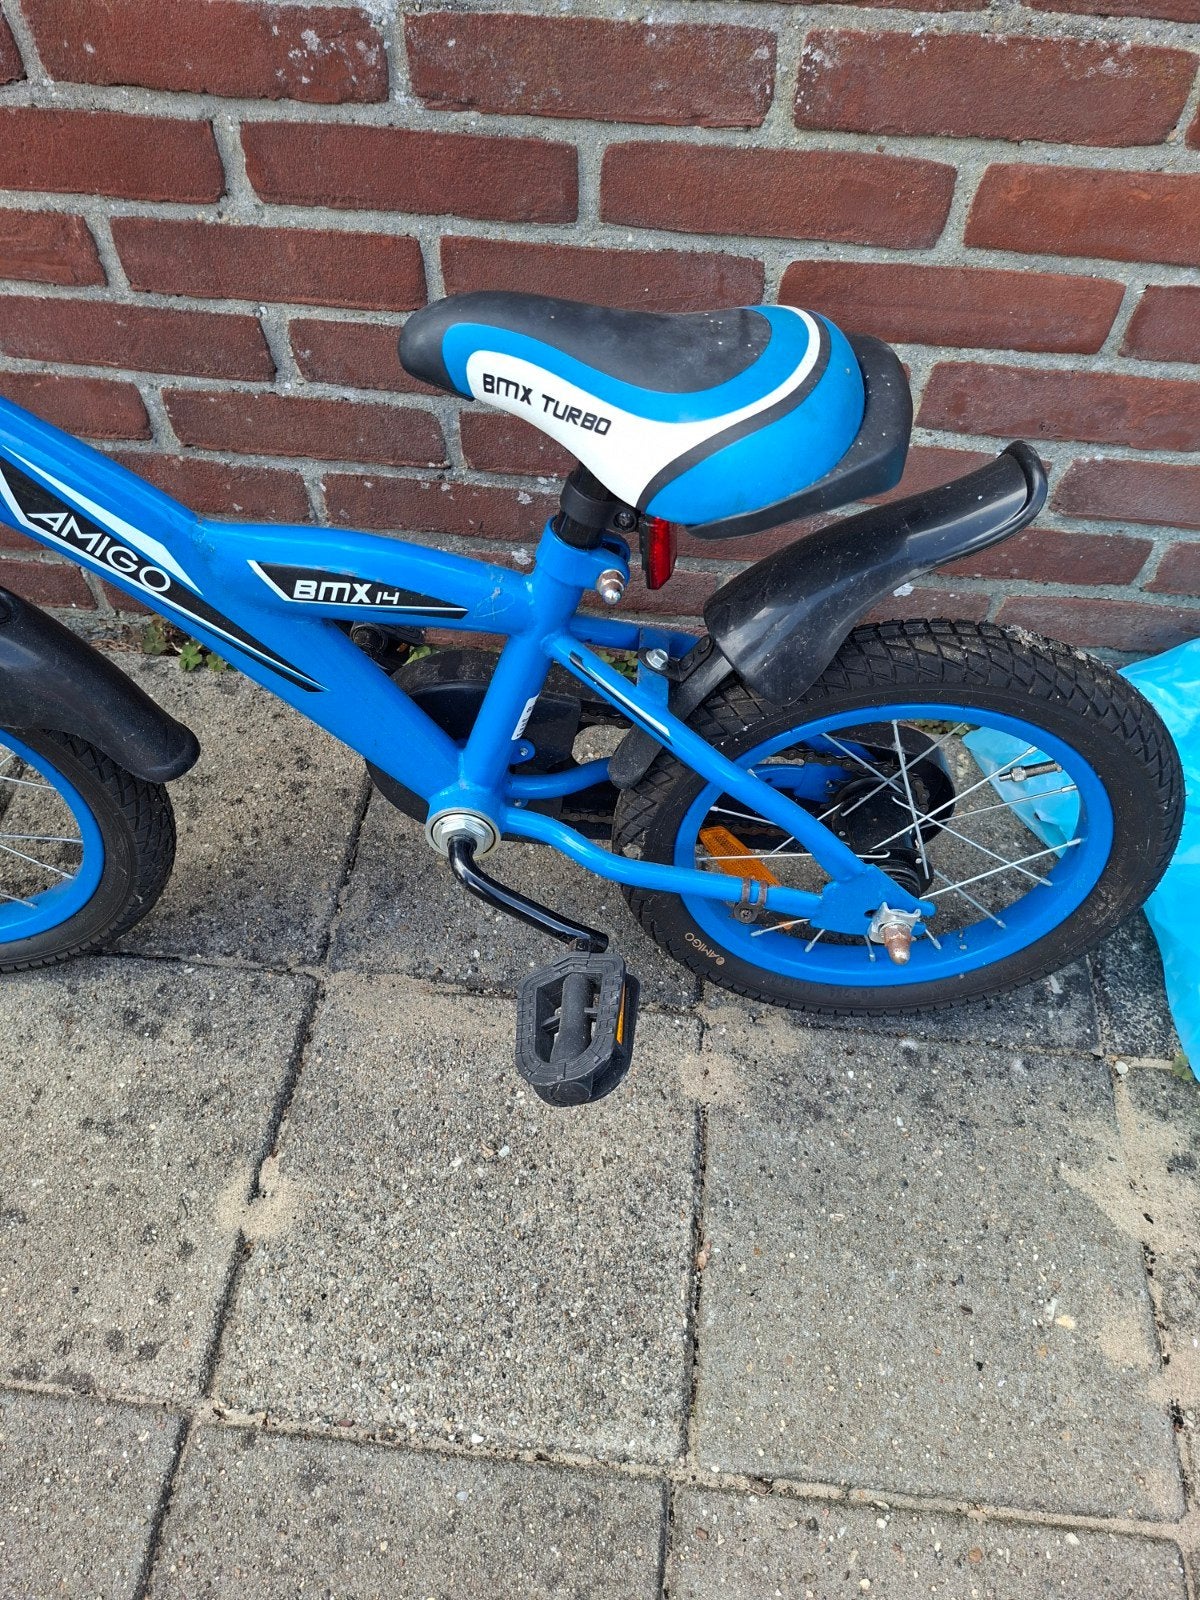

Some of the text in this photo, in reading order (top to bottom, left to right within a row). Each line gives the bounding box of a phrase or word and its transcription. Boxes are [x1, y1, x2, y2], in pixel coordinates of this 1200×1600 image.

[483, 373, 612, 436] BMX TURBO
[26, 512, 171, 592] AMIGO
[293, 579, 400, 605] BMX 14
[684, 932, 720, 958] AMIGO
